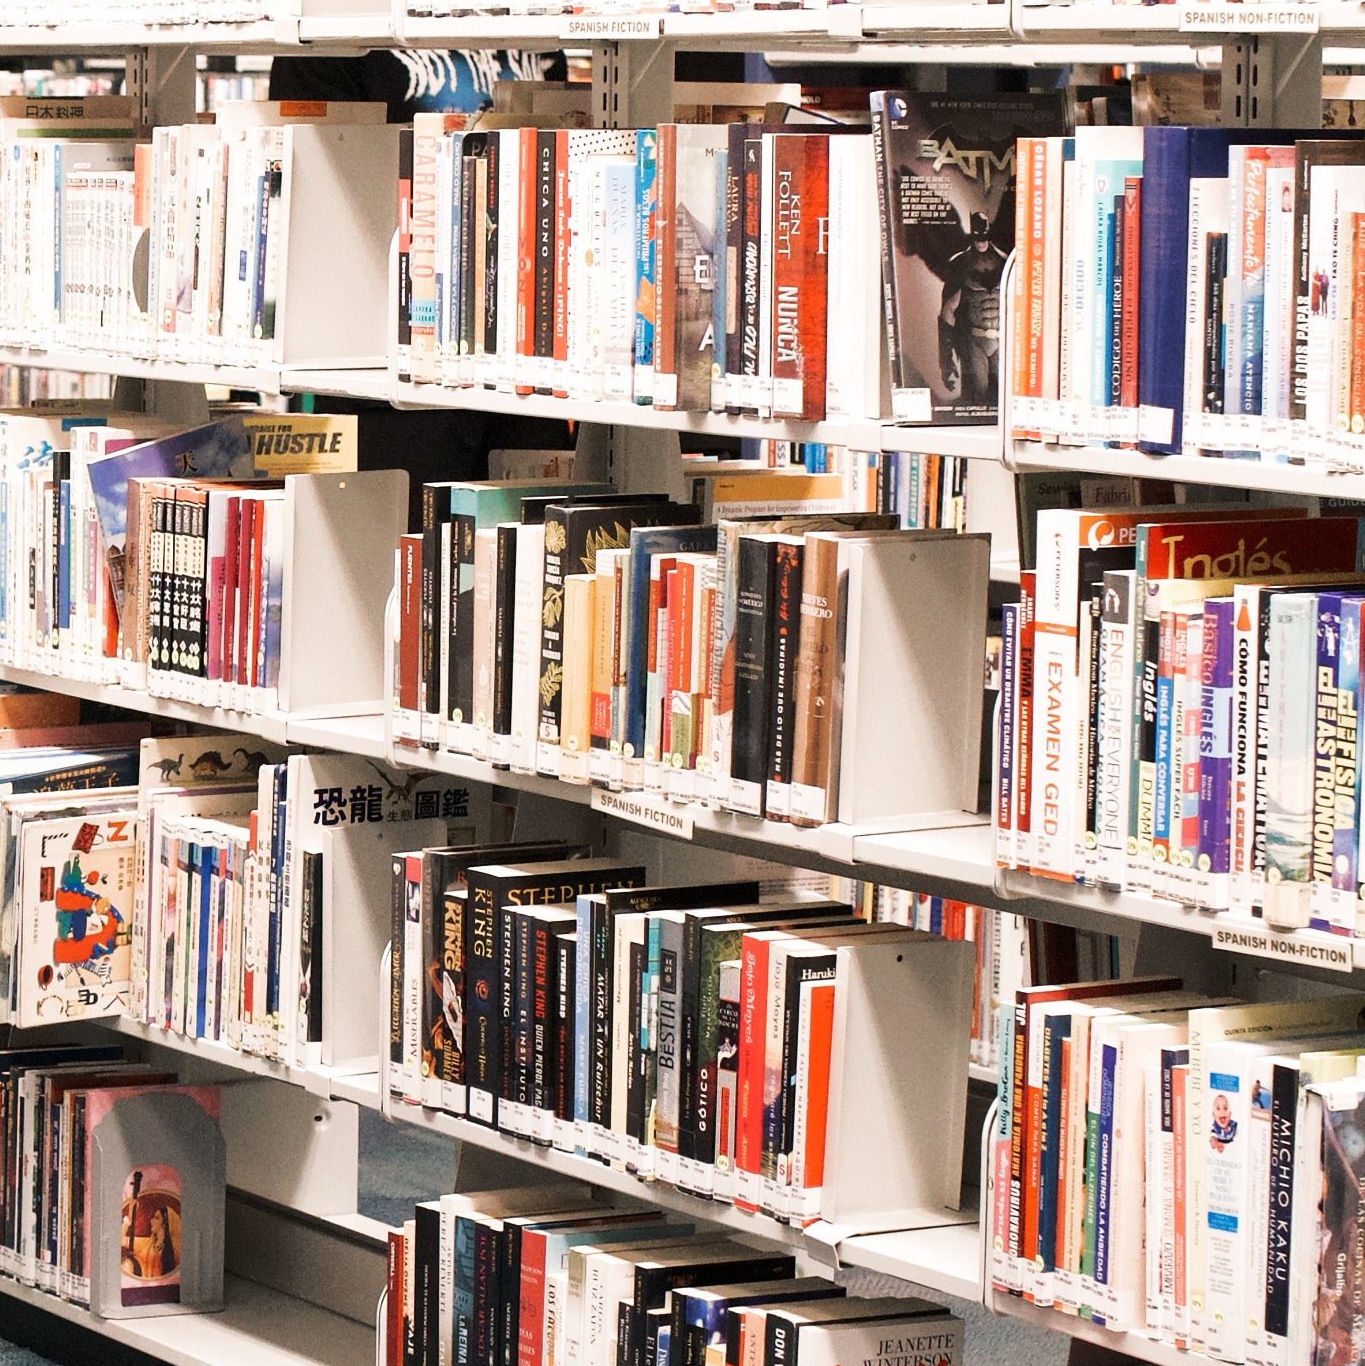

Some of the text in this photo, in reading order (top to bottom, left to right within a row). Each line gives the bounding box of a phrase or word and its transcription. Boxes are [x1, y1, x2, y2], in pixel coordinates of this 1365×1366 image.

[568, 21, 650, 34] SPANISH FICTION
[1184, 11, 1315, 25] SPANISH NON-FICTION
[872, 115, 883, 162] BATMAN
[413, 136, 436, 279] CARAMELO
[730, 175, 739, 222] LAURA
[778, 170, 791, 260] FOLLETT
[791, 194, 801, 236] KEN
[1033, 190, 1045, 239] LOZANO
[777, 285, 799, 362] NUNCA
[1244, 304, 1255, 411] MARIANA ATENCIO
[1293, 295, 1309, 405] LOS DOS PAPAS
[255, 432, 343, 456] HUSTLE
[1021, 646, 1033, 698] EMMA
[1202, 613, 1218, 684] Básico
[1142, 661, 1157, 723] Inglés
[1200, 687, 1217, 754] INGLÉS
[1236, 637, 1251, 775] CÓMO FUNCIONA
[1001, 668, 1012, 823] UN BILL GATES
[1043, 661, 1063, 836] EXAMEN GED
[1105, 629, 1124, 840] ENGLISH EVERYONE
[1156, 685, 1170, 832] INGLÉS PARA CONVERSAR
[312, 784, 384, 826] 恐龍
[415, 787, 469, 821] 圖鑑
[600, 793, 684, 829] SPANISH FICTION
[444, 900, 456, 972] KING
[473, 887, 486, 958] KING
[485, 890, 493, 958] STEPHEN
[582, 930, 590, 957] UNA
[1215, 929, 1348, 965] SPANISH NON-FICTION
[502, 914, 512, 1018] STEPHEN KING
[520, 920, 528, 999] STEPHEN KING
[535, 930, 546, 1019] STEPHEN KING
[576, 916, 584, 1014] DESCONOCIDA
[801, 967, 836, 982] Haruki
[409, 978, 418, 1058] MISERABLES
[594, 973, 604, 1056] MATAR UN
[744, 988, 755, 1044] Moyes
[772, 959, 782, 1039] Jojo Moyes
[519, 1010, 527, 1102] EL INSTITUTO
[534, 1053, 544, 1085] PIERDE
[1044, 1026, 1052, 1082] DIABETES
[698, 1068, 708, 1132] GÓTICO
[1096, 1133, 1110, 1281] COMBATIENDO LA ANSIEDAD
[1275, 1118, 1292, 1282] MICHIO KAKU
[1266, 1208, 1276, 1294] HUMANIDAD
[1335, 1252, 1347, 1296] Grijalbo
[457, 1327, 468, 1364] REINA
[773, 1327, 786, 1360] DON
[876, 1333, 955, 1357] JEANETTE
